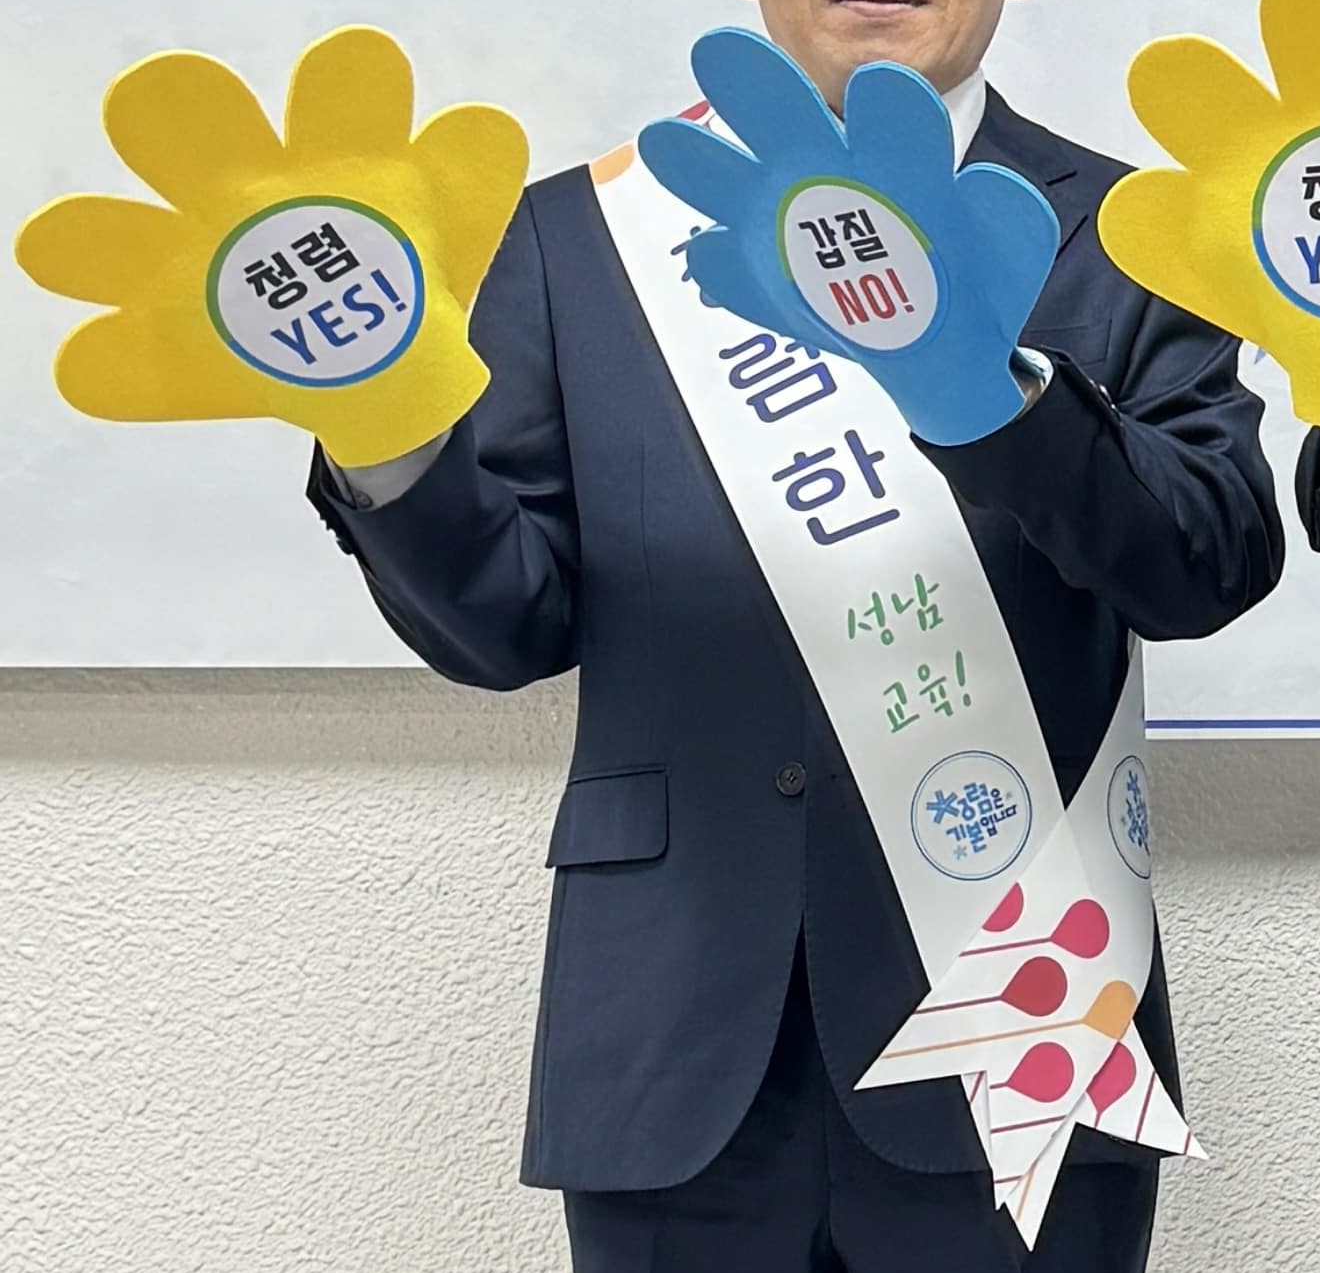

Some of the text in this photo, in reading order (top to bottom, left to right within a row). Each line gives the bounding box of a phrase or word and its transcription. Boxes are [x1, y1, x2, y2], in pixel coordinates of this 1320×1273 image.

[243, 221, 361, 310] 청렴
[798, 208, 889, 270] 갑질
[270, 268, 407, 365] YES!
[828, 267, 915, 326] NO!
[671, 225, 900, 546] 렴한
[845, 574, 941, 648] 성남
[882, 652, 974, 734] 교육!
[946, 804, 1018, 854] 기본입니다
